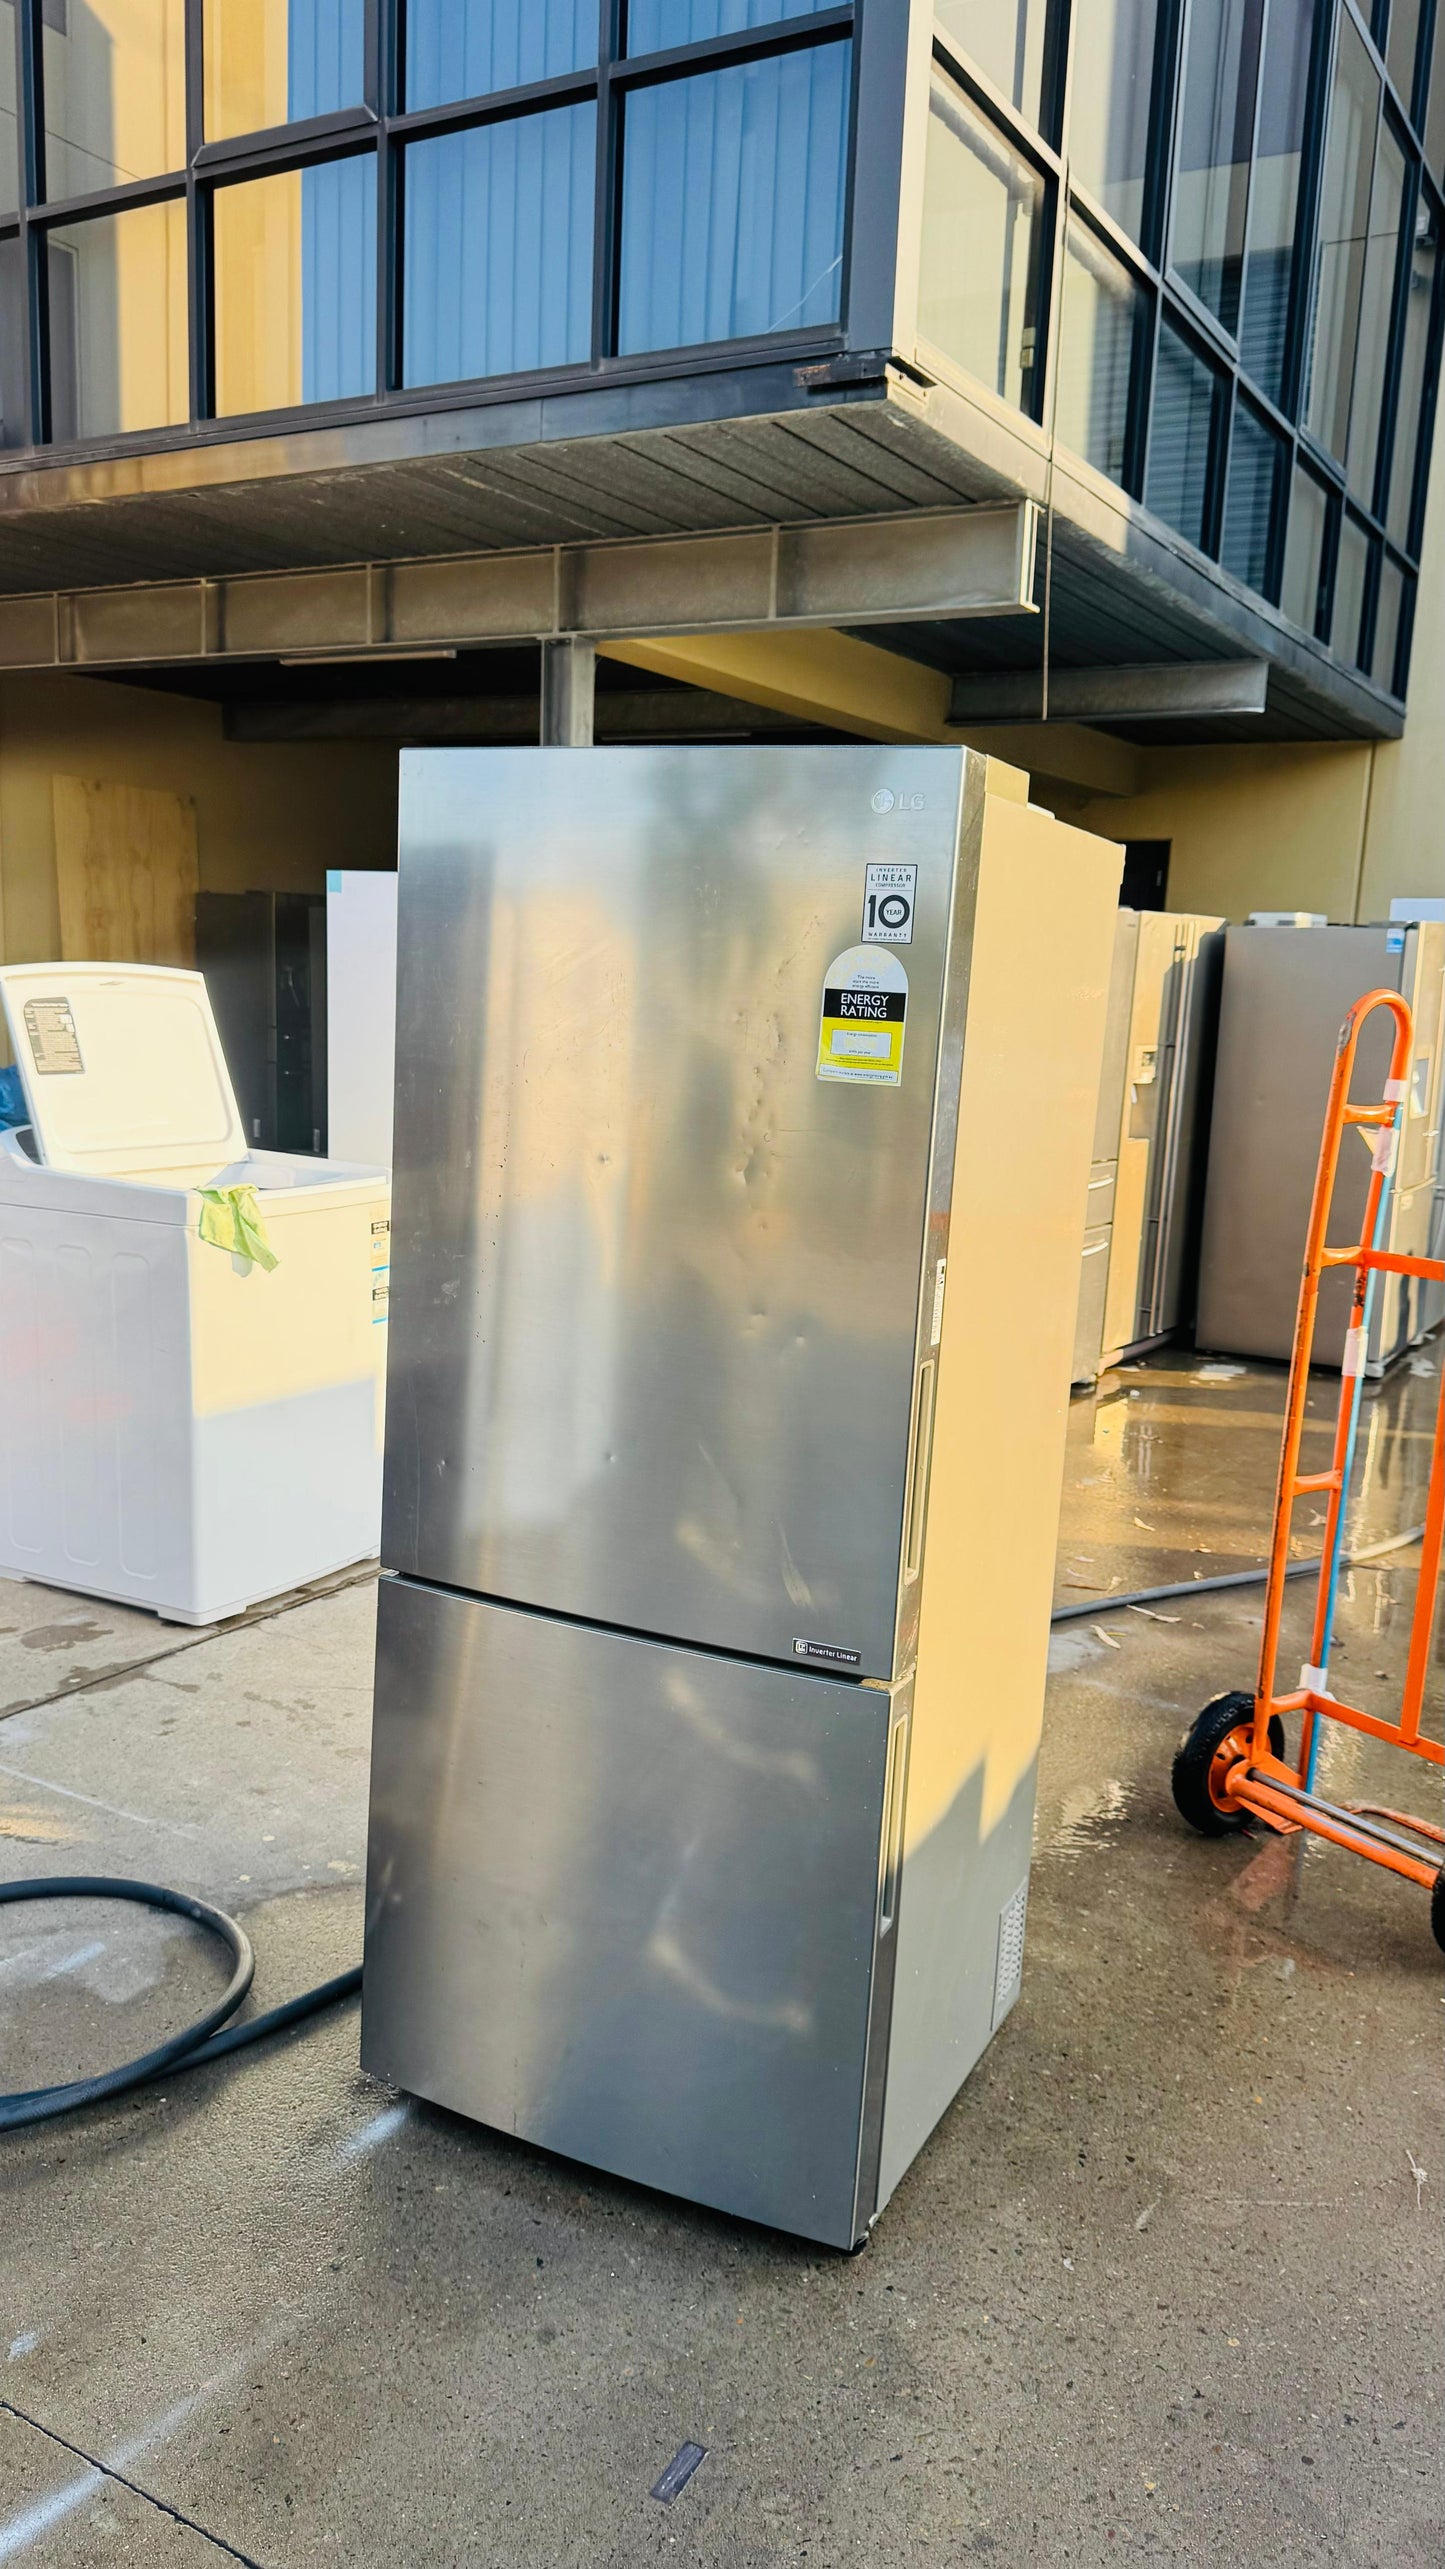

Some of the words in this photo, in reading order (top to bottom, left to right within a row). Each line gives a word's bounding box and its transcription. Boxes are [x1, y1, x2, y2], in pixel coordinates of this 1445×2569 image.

[899, 793, 925, 810] LG
[871, 874, 911, 882] LINEAR
[868, 894, 910, 929] 10
[841, 993, 889, 1006] ENERGY
[840, 1005, 888, 1018] RATING
[809, 1646, 836, 1657] Inverter
[836, 1652, 858, 1662] Linear
